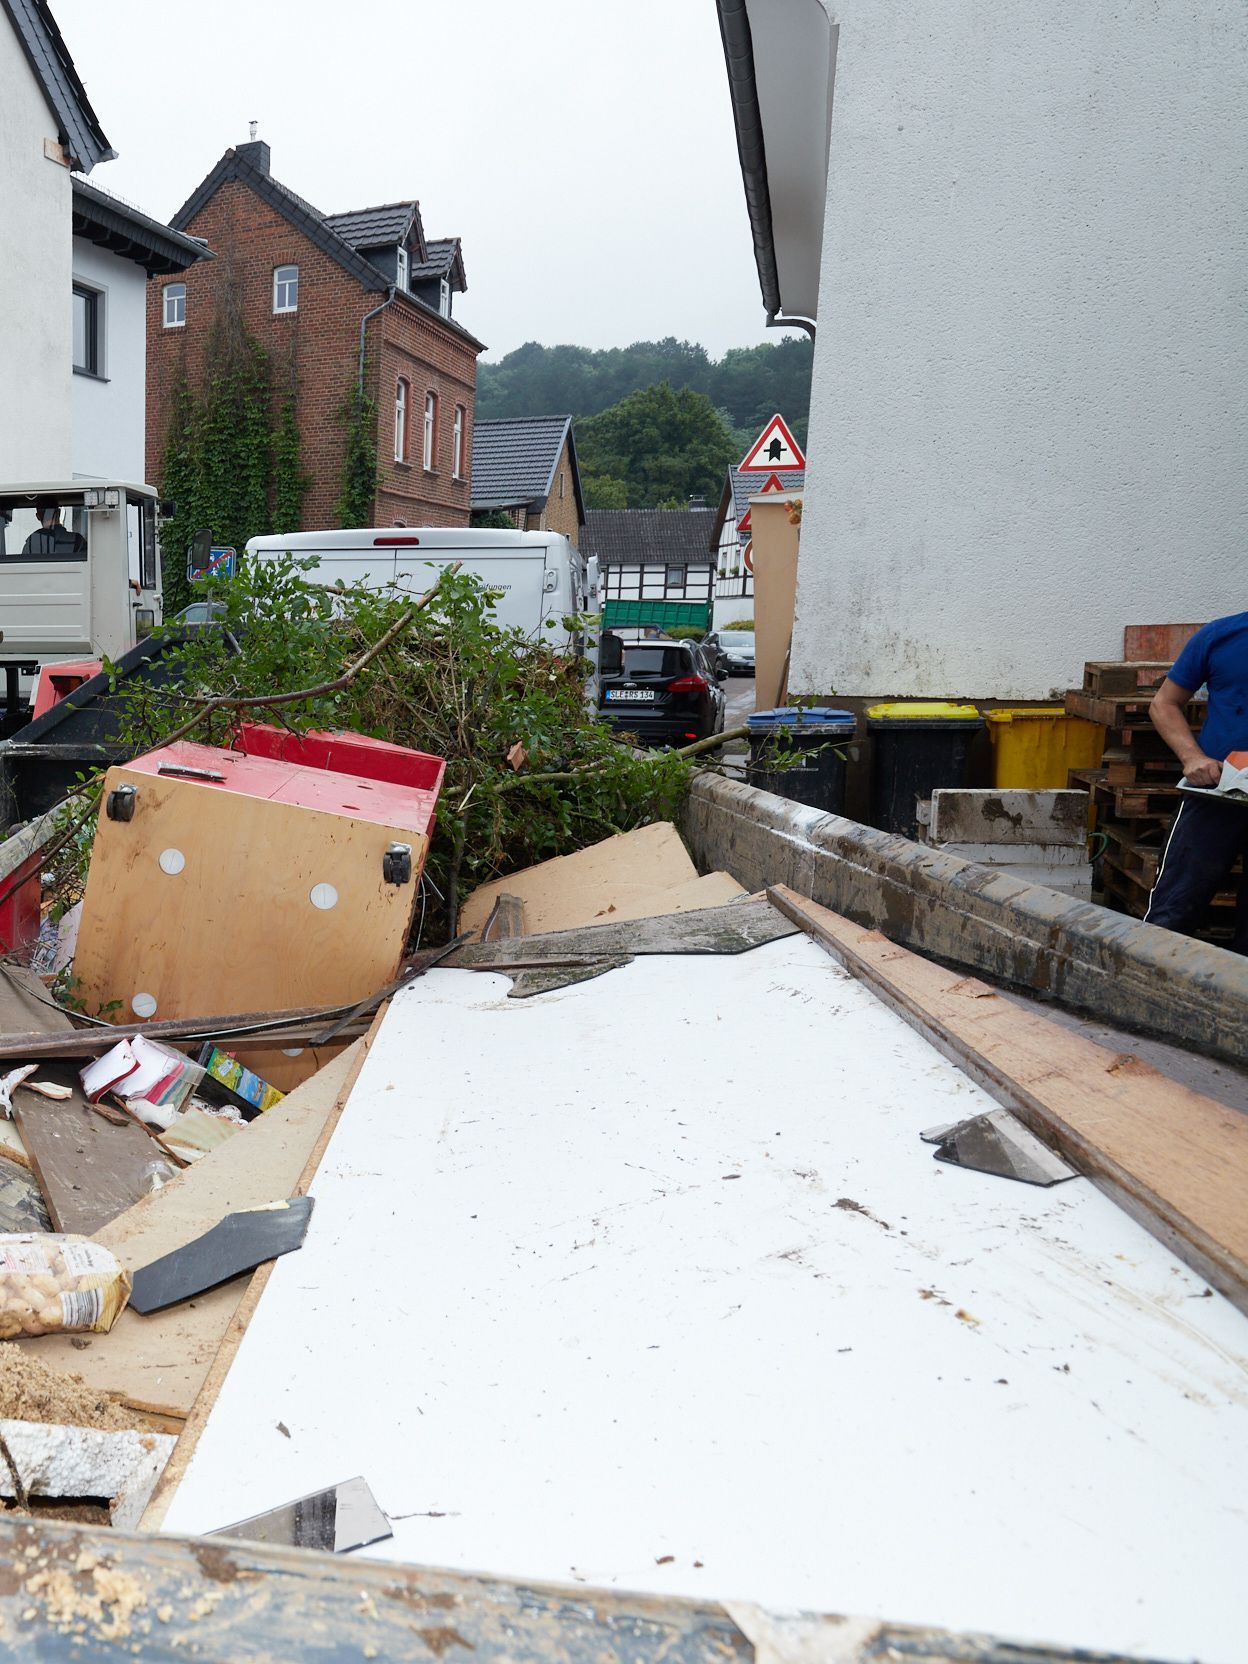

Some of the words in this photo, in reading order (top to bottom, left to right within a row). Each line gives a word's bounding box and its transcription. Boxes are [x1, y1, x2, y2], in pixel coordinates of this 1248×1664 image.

[610, 690, 624, 699] SLE
[629, 690, 639, 699] RS
[640, 690, 653, 699] 134
